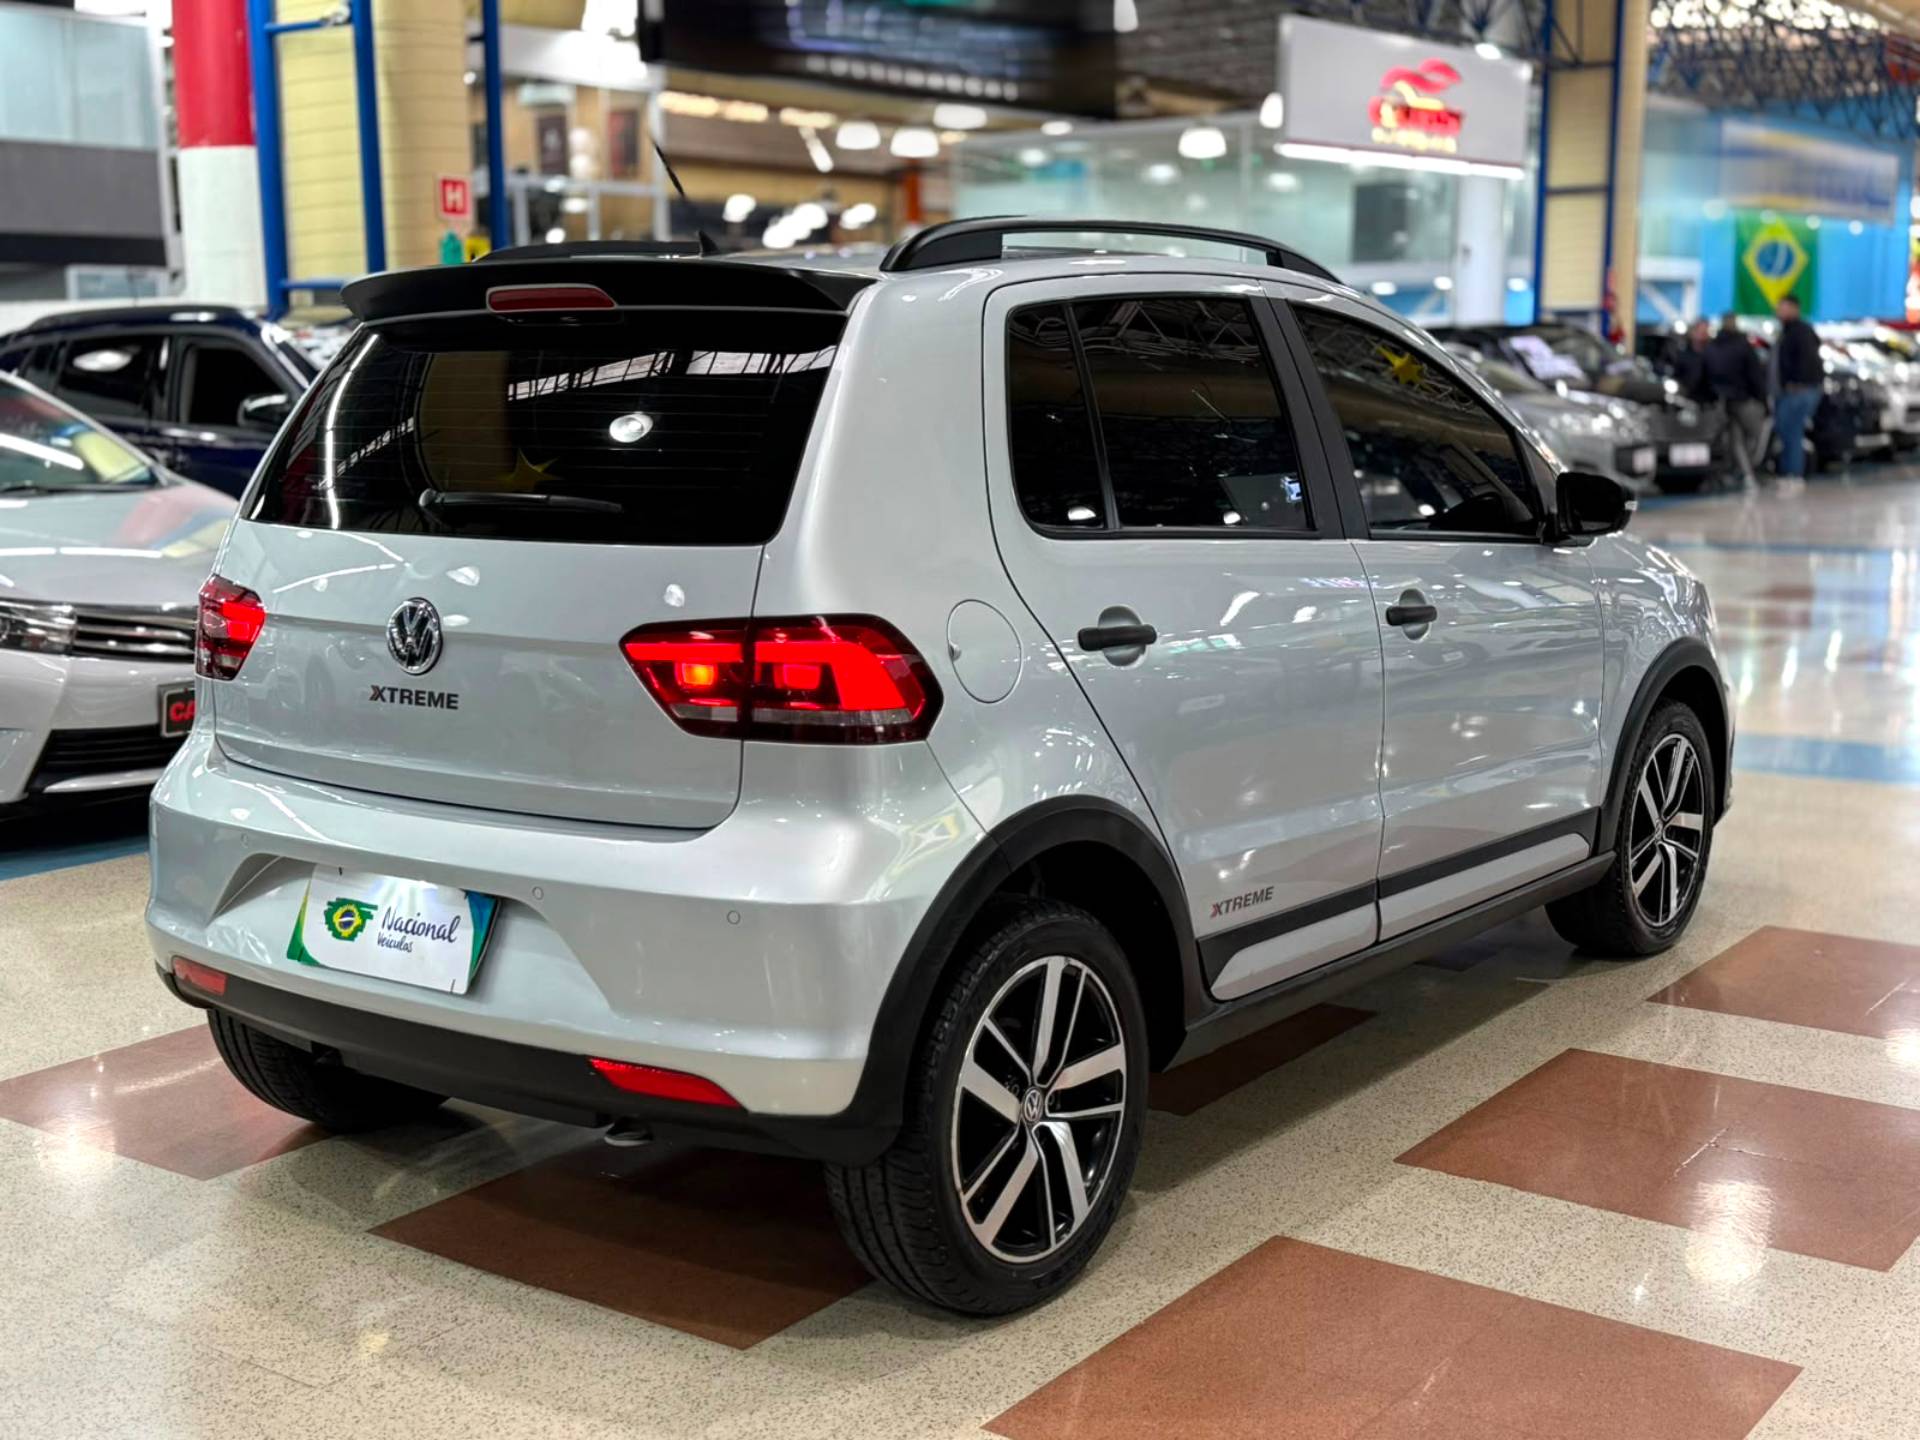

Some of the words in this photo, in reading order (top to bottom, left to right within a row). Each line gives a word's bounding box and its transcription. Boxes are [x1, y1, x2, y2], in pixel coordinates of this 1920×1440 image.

[445, 183, 464, 211] H
[369, 685, 459, 710] XTREME
[1210, 885, 1274, 918] XTREME
[382, 906, 461, 943] Nacional
